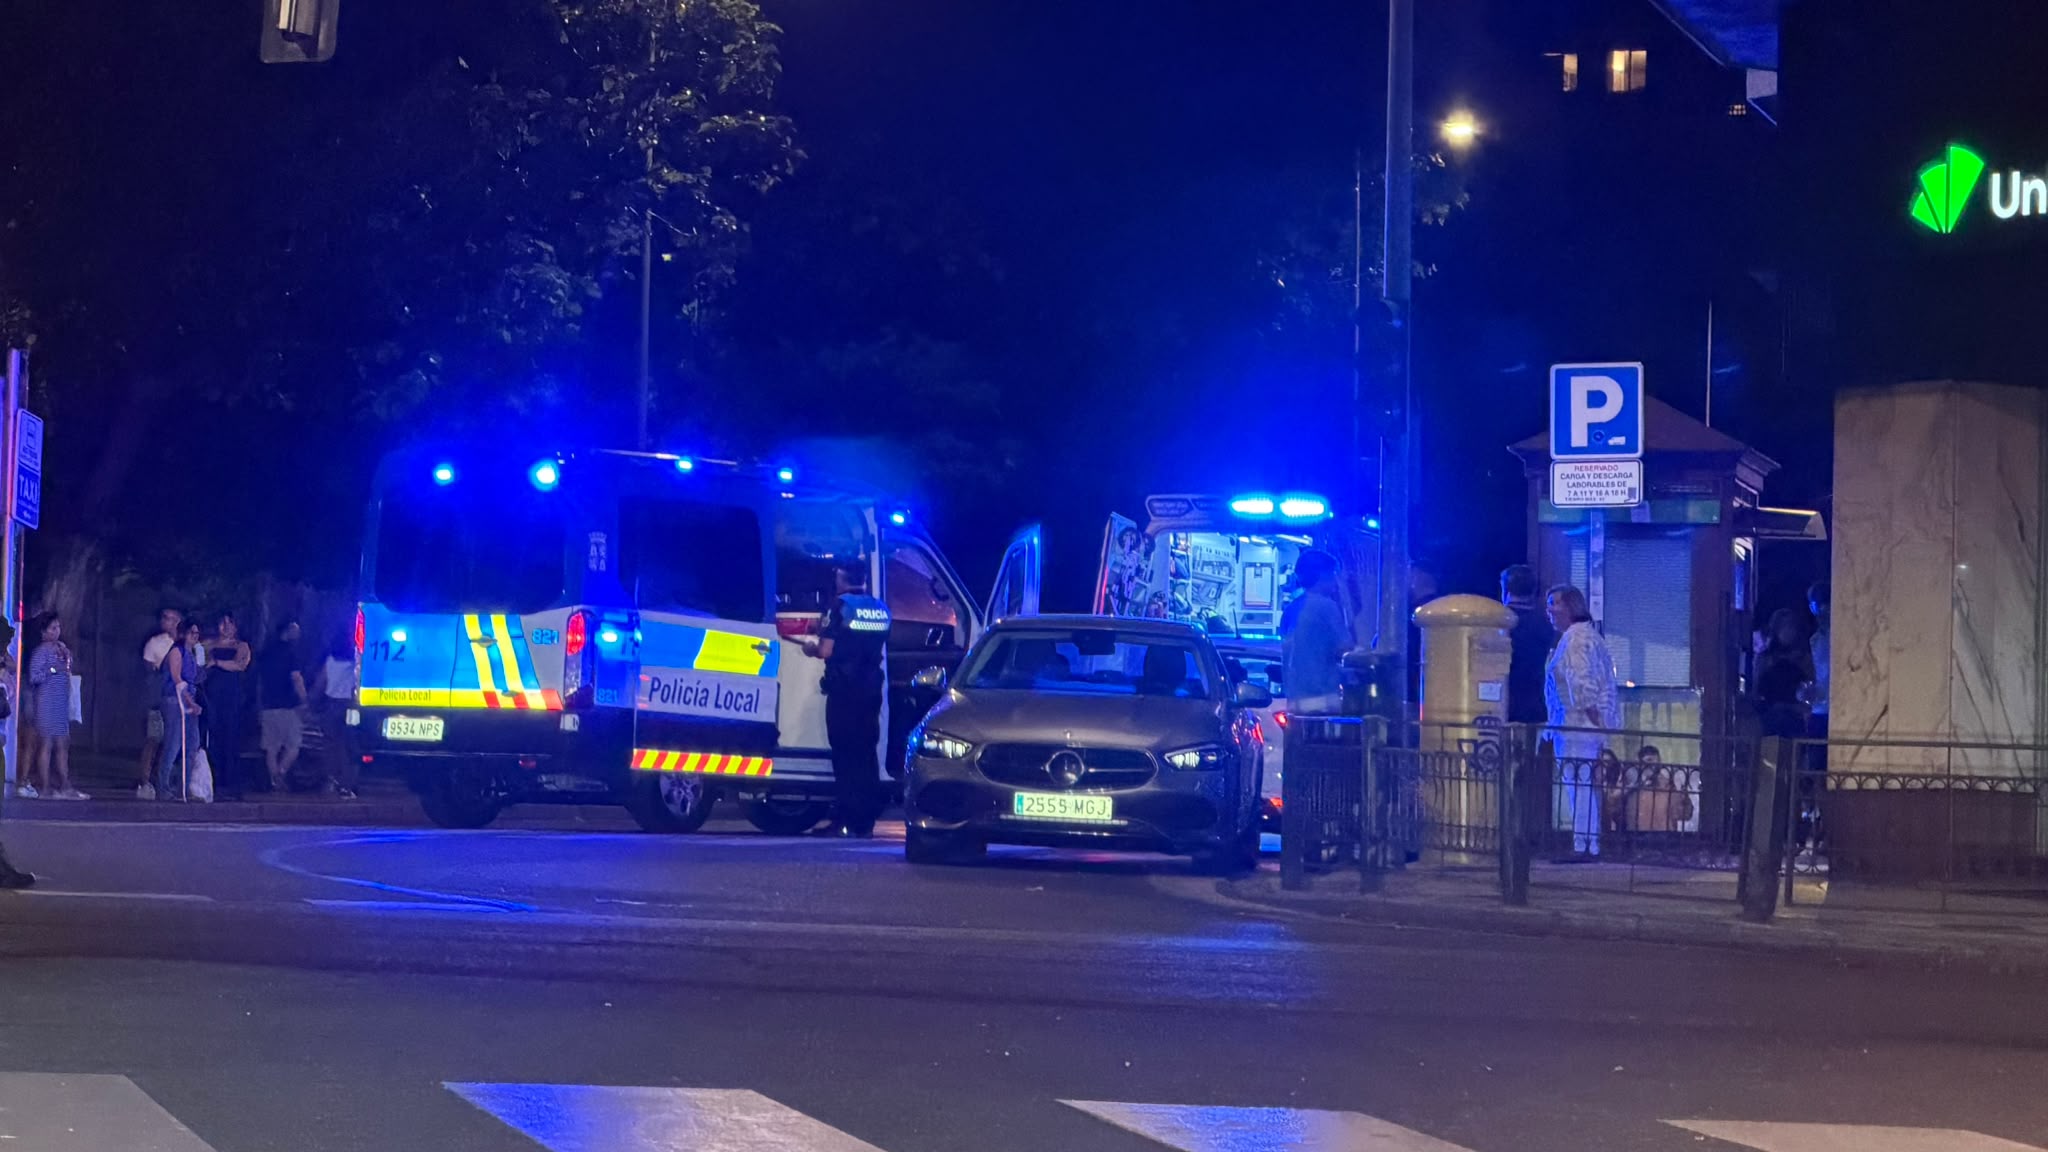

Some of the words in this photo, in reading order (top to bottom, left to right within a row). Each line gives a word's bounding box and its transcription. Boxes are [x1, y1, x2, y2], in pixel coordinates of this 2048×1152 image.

[1571, 375, 1624, 448] P
[19, 475, 38, 504] TAXI
[1616, 480, 1627, 488] DE
[531, 628, 560, 646] 821
[369, 639, 405, 663] 112
[408, 688, 431, 702] Local
[597, 687, 618, 703] 821
[648, 674, 710, 708] Policía
[714, 682, 760, 714] Local
[389, 718, 415, 736] 9534
[419, 719, 440, 737] NPS
[1025, 796, 1067, 814] 2555
[1074, 798, 1106, 816] MGJ
